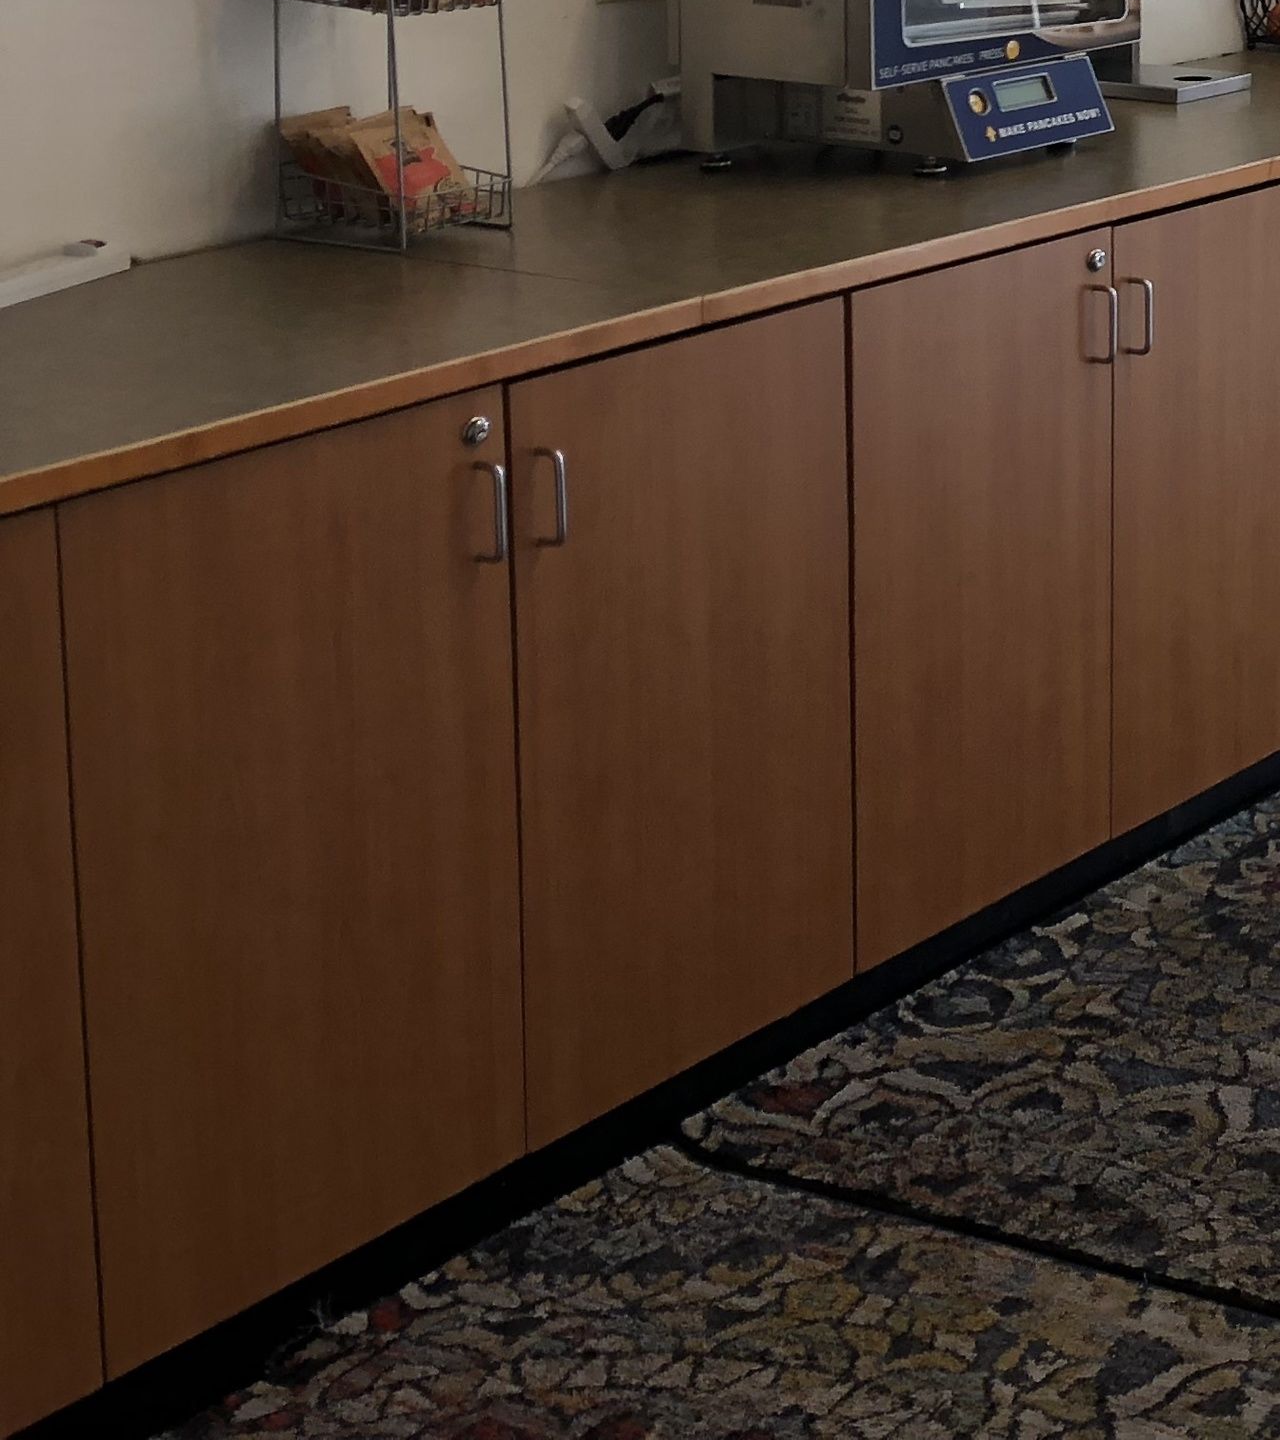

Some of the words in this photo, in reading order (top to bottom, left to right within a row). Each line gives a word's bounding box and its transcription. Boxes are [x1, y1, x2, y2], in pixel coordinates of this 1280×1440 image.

[879, 61, 928, 79] SELF-SERVE
[929, 53, 975, 68] PANCAKES
[998, 123, 1026, 138] MAKE
[1027, 113, 1076, 131] PANCAKES
